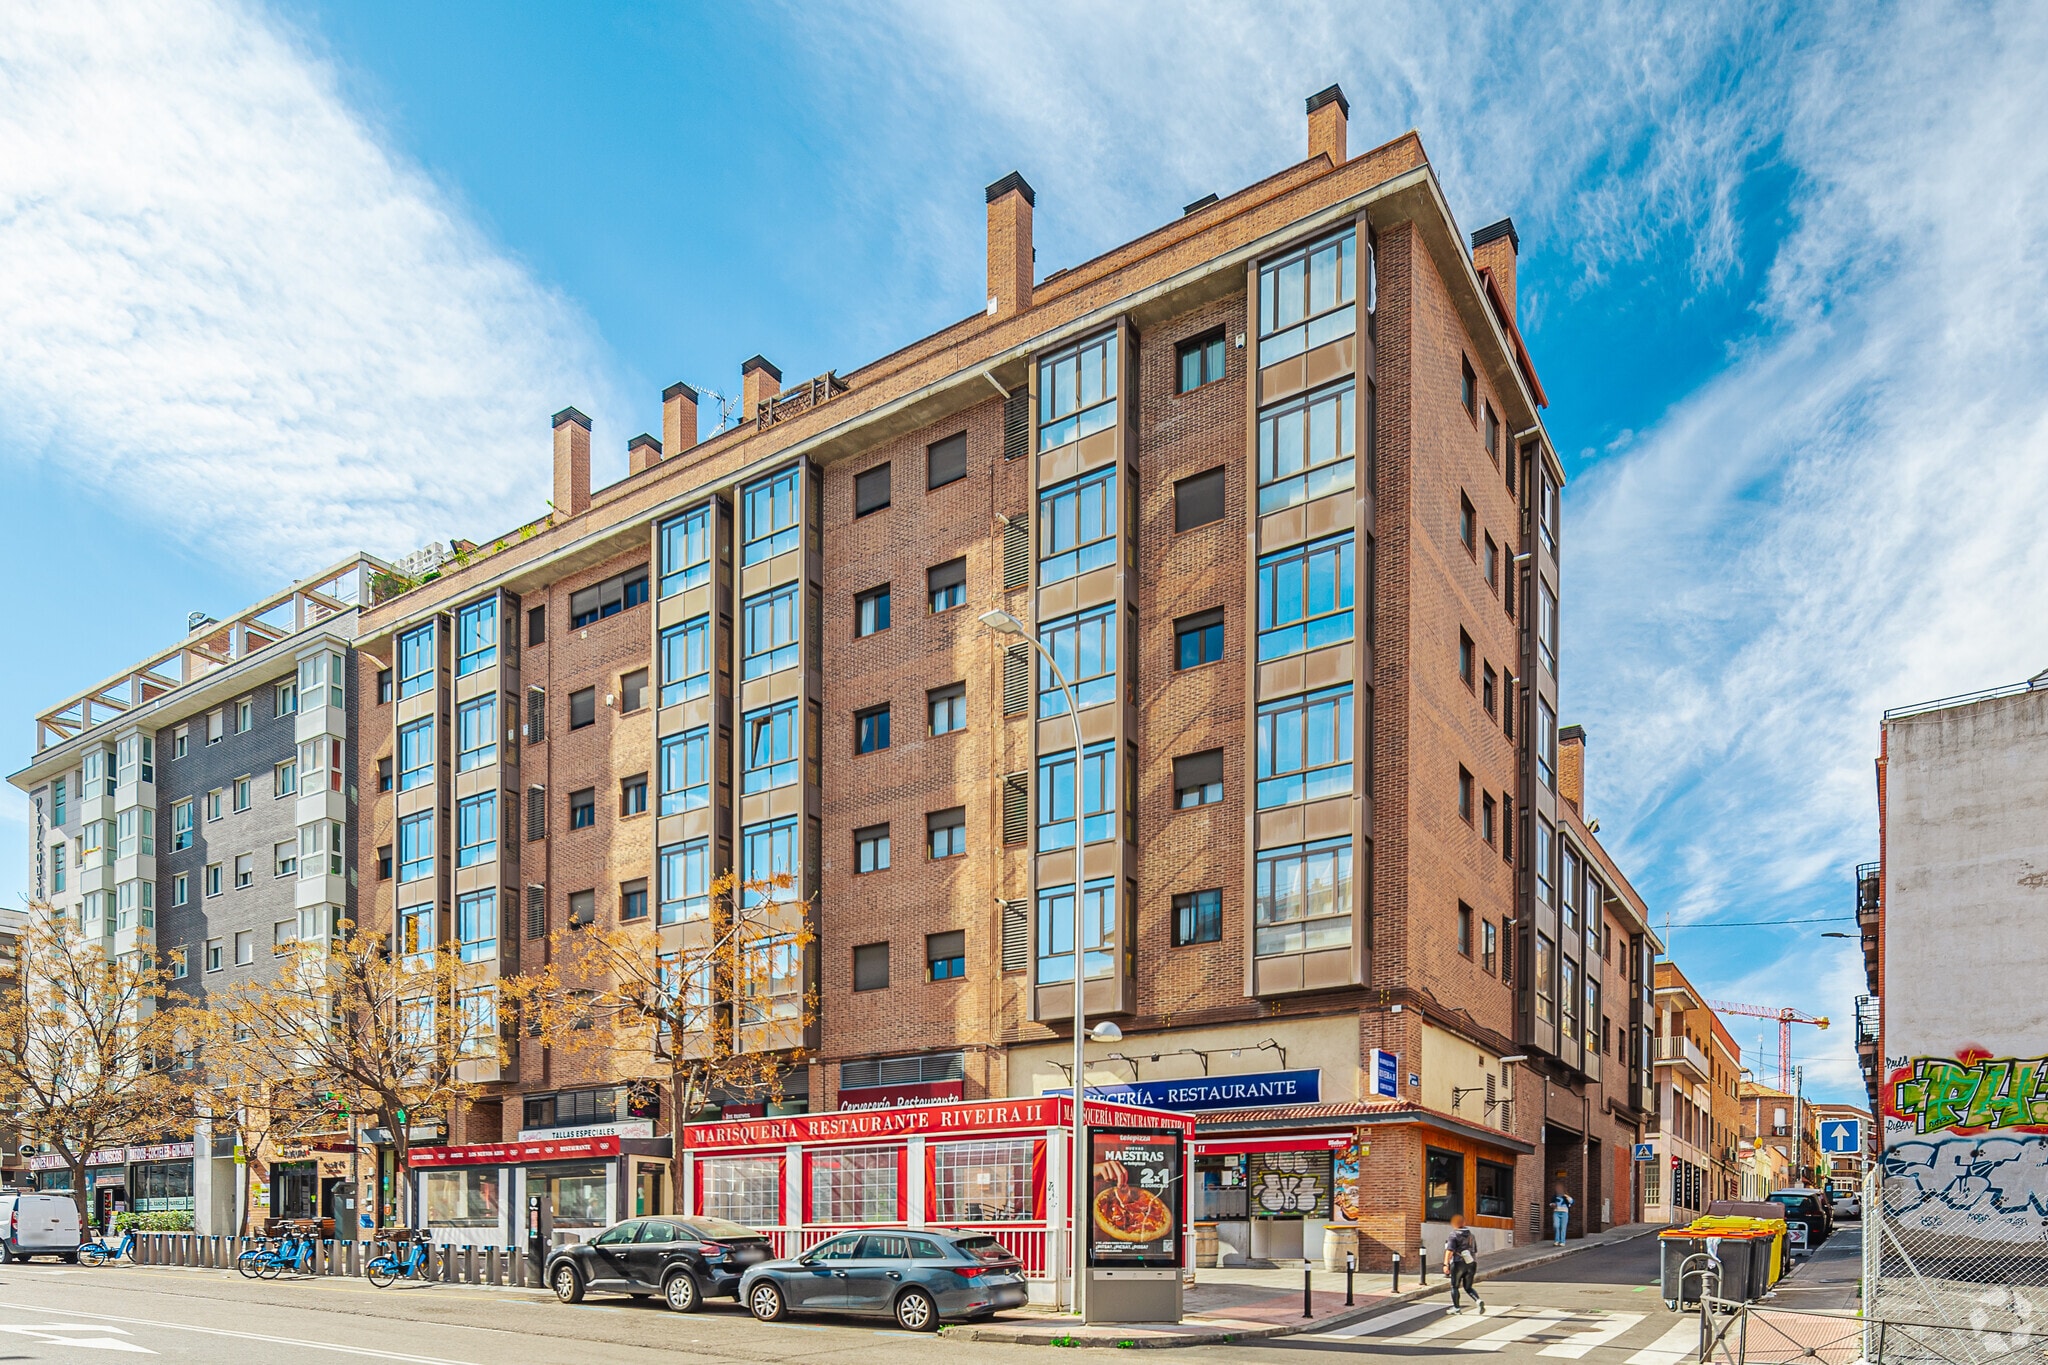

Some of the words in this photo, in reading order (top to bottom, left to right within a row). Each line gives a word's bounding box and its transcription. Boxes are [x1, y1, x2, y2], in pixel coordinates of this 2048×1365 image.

[1168, 1080, 1297, 1103] RESTAURANTE
[695, 1119, 798, 1144] MARISQUERÍA
[809, 1112, 929, 1136] RESTAURANTE
[941, 1107, 1021, 1127] RIVEIRA
[1026, 1104, 1042, 1121] II
[1114, 1111, 1160, 1128] RESTAURANTE
[552, 1130, 575, 1139] TALLAS
[576, 1127, 615, 1138] ESPECIALES
[1120, 1134, 1151, 1143] telepizza
[1105, 1150, 1164, 1162] MAESTRAS
[1140, 1168, 1169, 1184] 2x1
